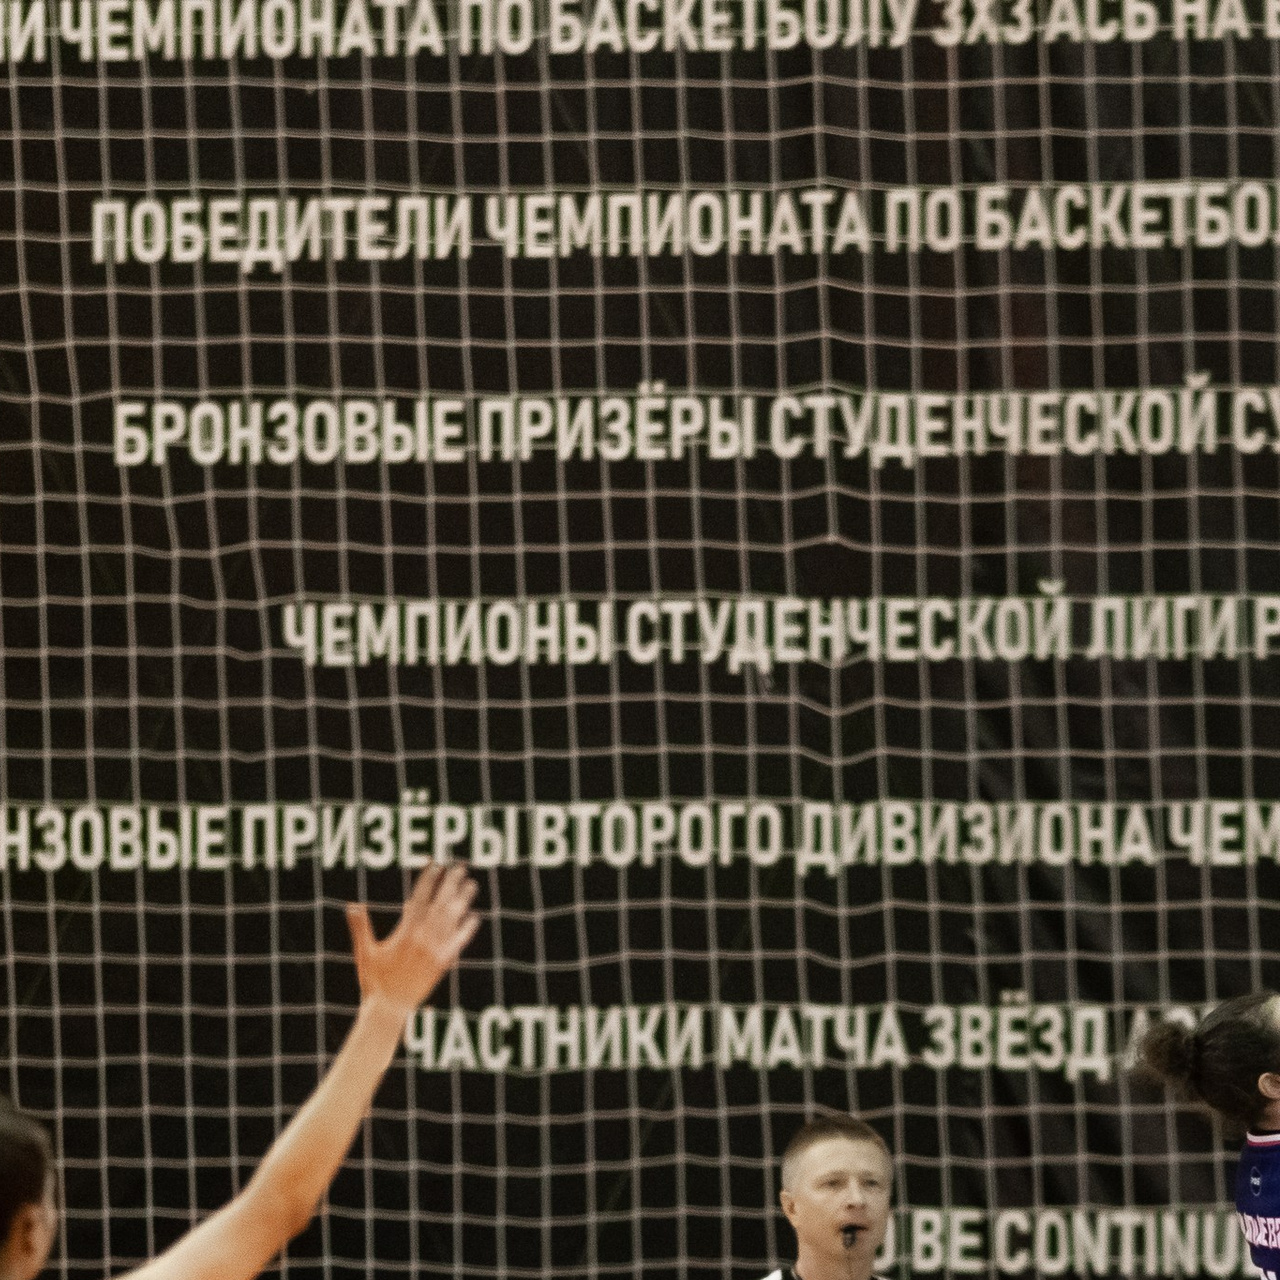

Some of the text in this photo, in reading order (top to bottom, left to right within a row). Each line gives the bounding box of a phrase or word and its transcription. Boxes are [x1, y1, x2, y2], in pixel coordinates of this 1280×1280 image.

[0, 0, 46, 63] И
[60, 0, 445, 62] ЧЕМПИОНАТА
[459, 0, 533, 56] ПО
[549, 0, 913, 55] БАСКЕТБОЛУ
[92, 196, 472, 274] ПОБЕДИТЕЛИ
[485, 190, 869, 259] ЧЕМПИОНАТА
[885, 186, 961, 253] ПО
[114, 400, 467, 467] БРОНЗОВЫЕ
[479, 382, 757, 463] ПРИЗЁРЫ
[769, 372, 1221, 469] СТУДЕНЧЕСКОЙ
[283, 598, 615, 667] ЧЕМПИОНЫ
[625, 579, 1072, 675] СТУДЕНЧЕСКОЙ
[1086, 596, 1240, 661] ЛИГИ
[0, 803, 230, 872] НЗОВЫЕ
[241, 788, 520, 871] ПРИЗЁРЫ
[534, 803, 784, 869] ВТОРОГО
[797, 799, 1159, 877] ДИВИЗИОНА
[403, 1004, 706, 1072] ЧАСТНИКИ
[718, 1003, 910, 1069] МАТЧА
[922, 990, 1111, 1083] ЗВЁЗД
[912, 1208, 986, 1273] BE
[998, 1209, 1263, 1277] CONTINU
